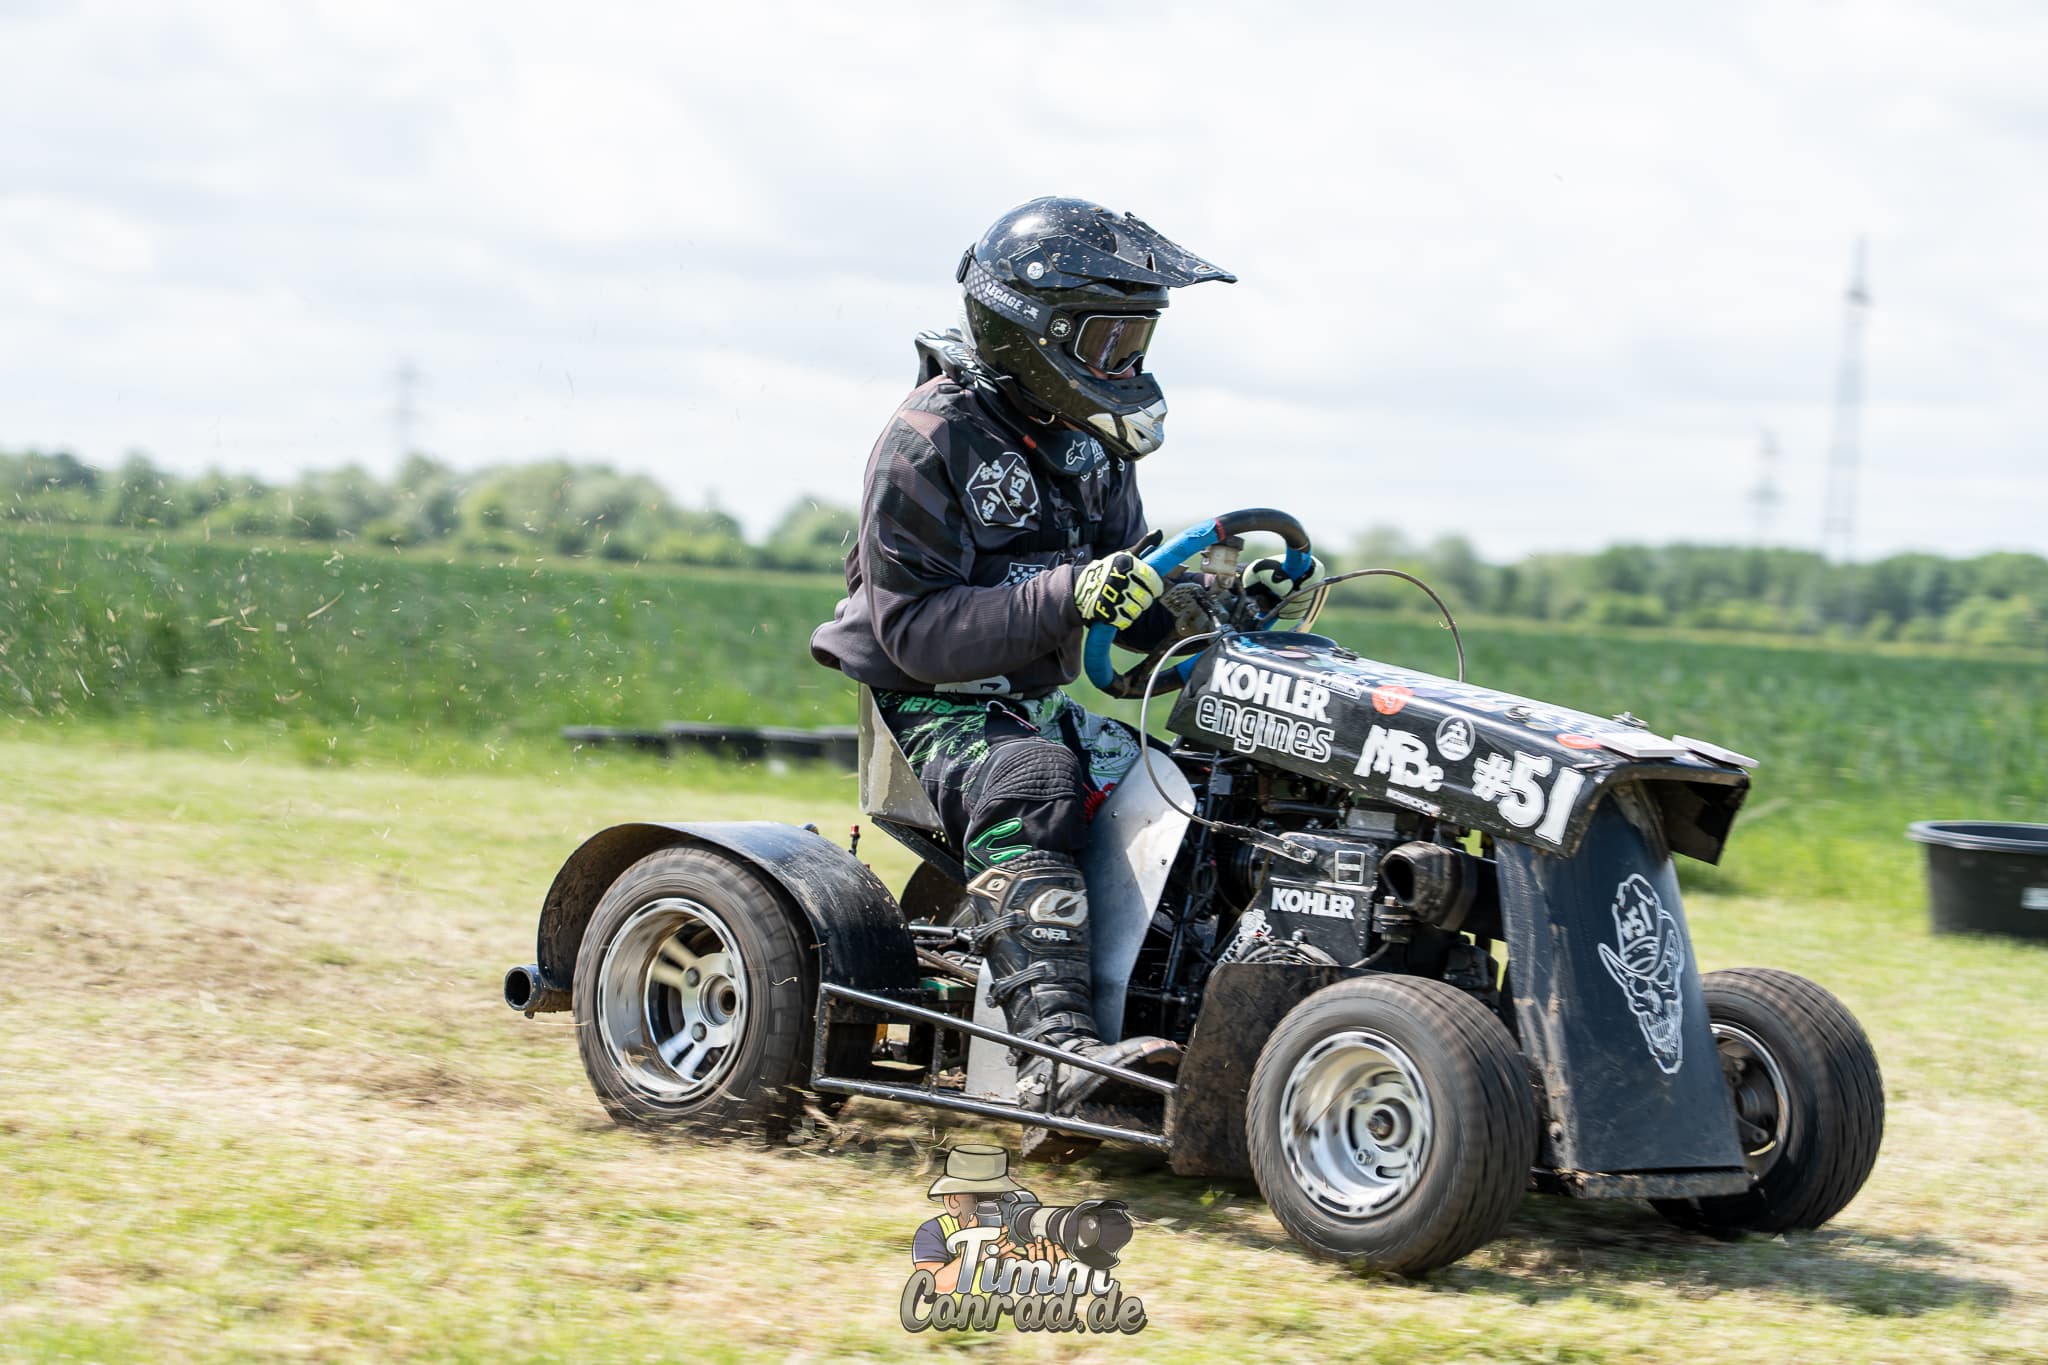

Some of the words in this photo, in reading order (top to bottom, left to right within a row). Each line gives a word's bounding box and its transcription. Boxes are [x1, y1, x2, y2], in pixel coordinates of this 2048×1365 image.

[1210, 657, 1333, 724] KOHLER
[1195, 694, 1335, 764] engines
[1472, 750, 1586, 846] #51
[1270, 887, 1355, 920] KOHLER
